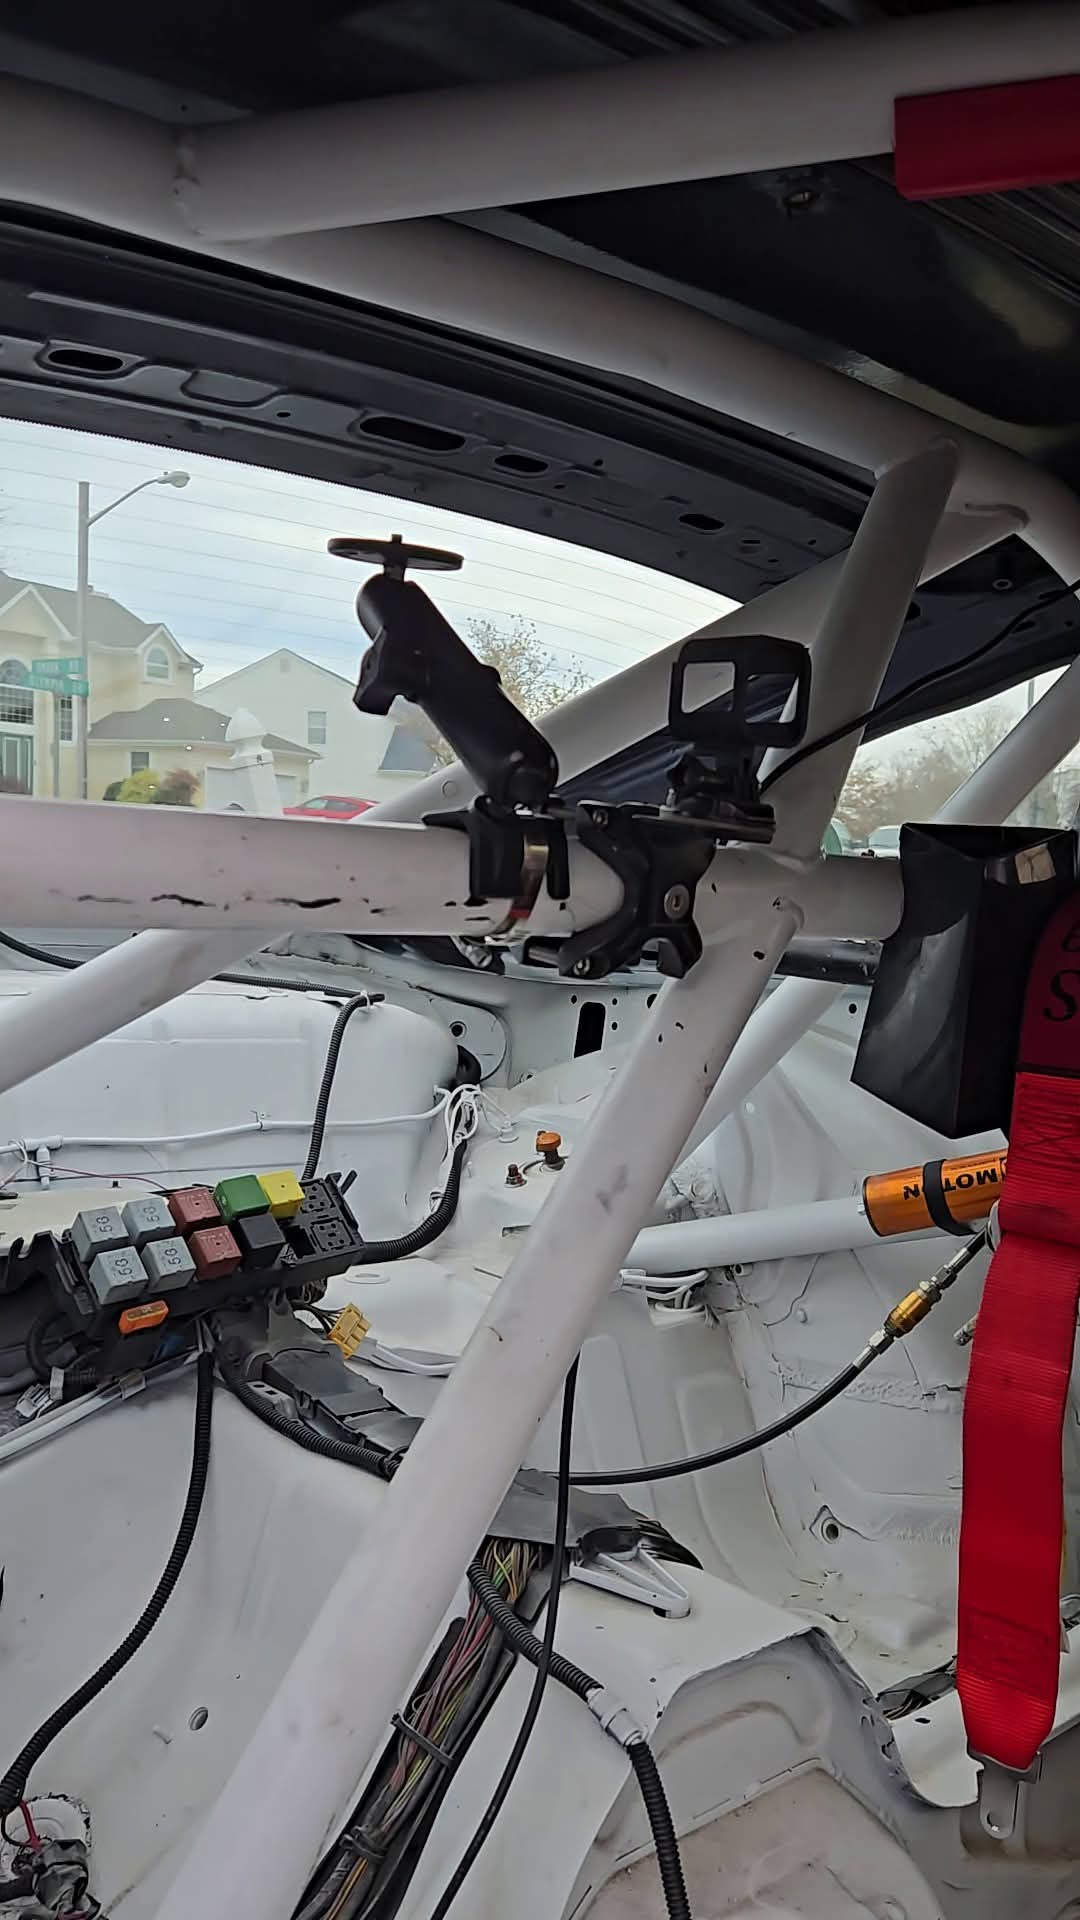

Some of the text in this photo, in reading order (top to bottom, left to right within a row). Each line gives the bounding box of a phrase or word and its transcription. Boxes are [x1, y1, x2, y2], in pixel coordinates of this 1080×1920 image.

[903, 1168, 997, 1200] MOTN
[165, 1247, 181, 1265] 53
[115, 1258, 132, 1276] 53
